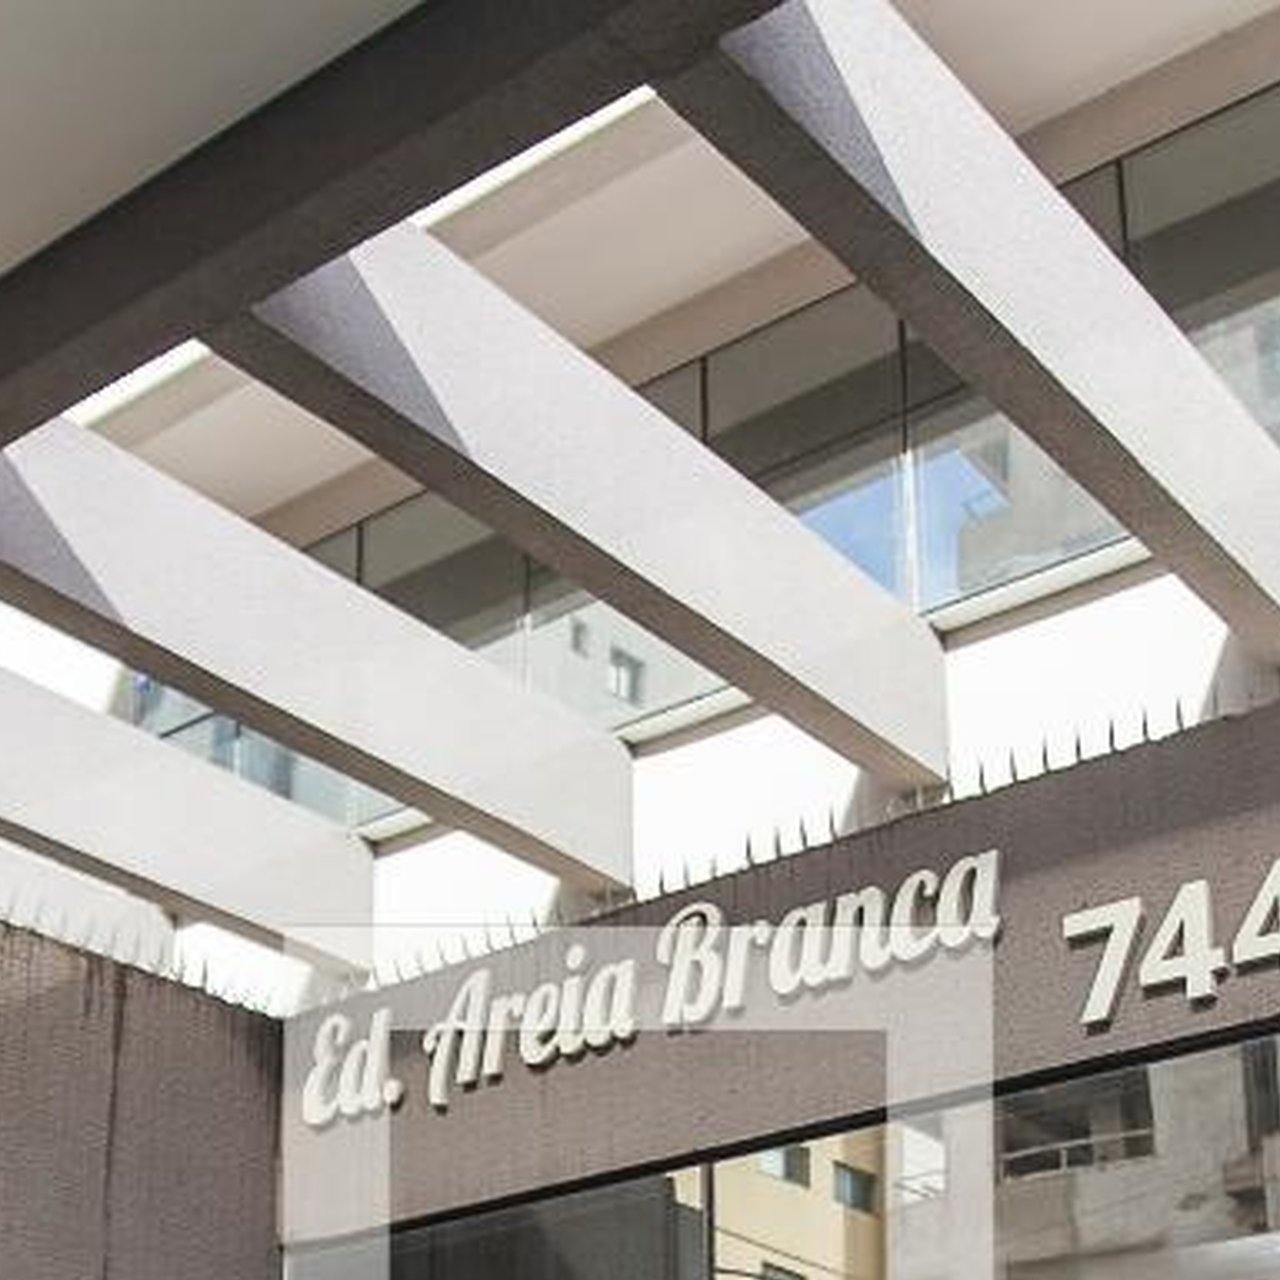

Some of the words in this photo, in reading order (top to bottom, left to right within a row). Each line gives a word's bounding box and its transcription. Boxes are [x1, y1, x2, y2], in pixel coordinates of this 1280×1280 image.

[302, 1007, 402, 1124] Ed.
[423, 944, 637, 1106] Areia
[657, 849, 1001, 1029] Branca
